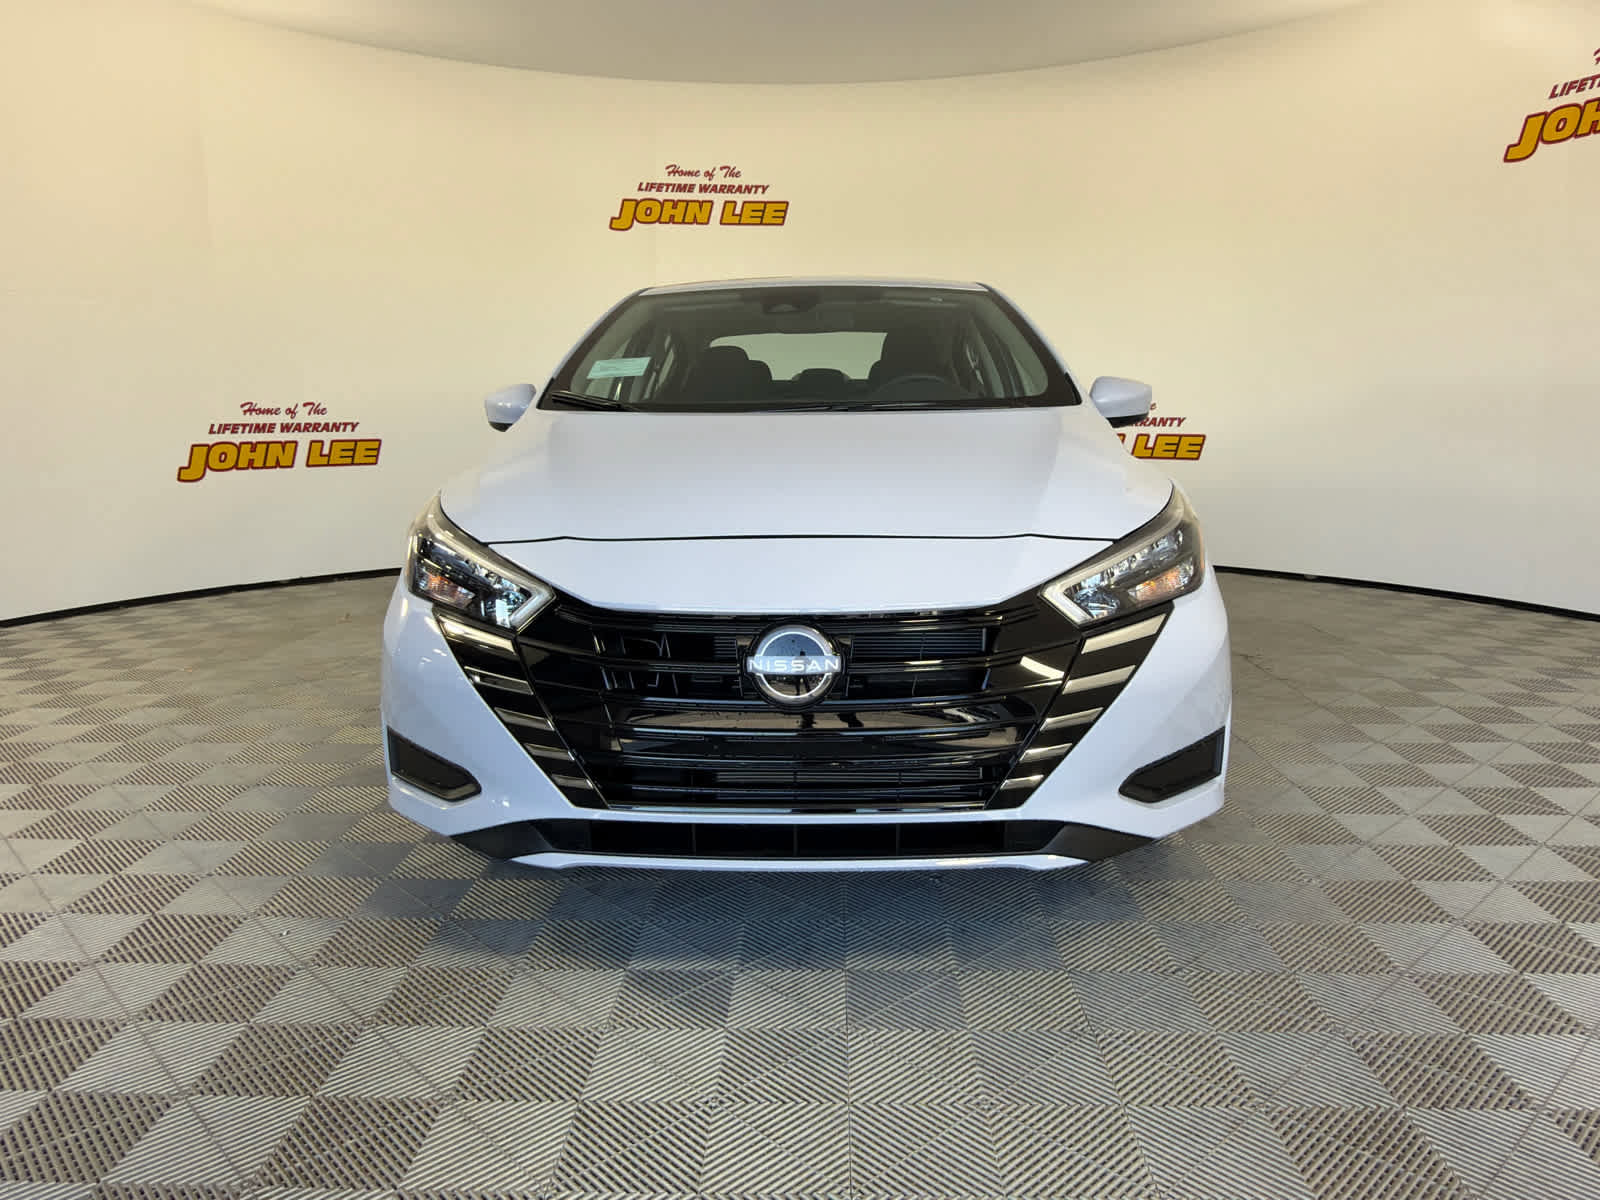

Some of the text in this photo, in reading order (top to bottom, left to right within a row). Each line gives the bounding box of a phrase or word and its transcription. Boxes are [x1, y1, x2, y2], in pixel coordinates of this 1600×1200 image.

[1548, 73, 1600, 99] LIFET
[1503, 97, 1600, 162] JOH
[664, 164, 742, 181] Home of The
[637, 182, 770, 194] LIFETIME WARRANTY
[609, 198, 789, 231] JOHN LEE
[239, 401, 328, 419] Home of The
[208, 421, 360, 435] LIFETIME WARRANTY
[1134, 416, 1186, 428] RANTY
[1131, 433, 1206, 460] LEE
[176, 438, 382, 483] JOHN LEE
[748, 659, 840, 672] NISSAN
